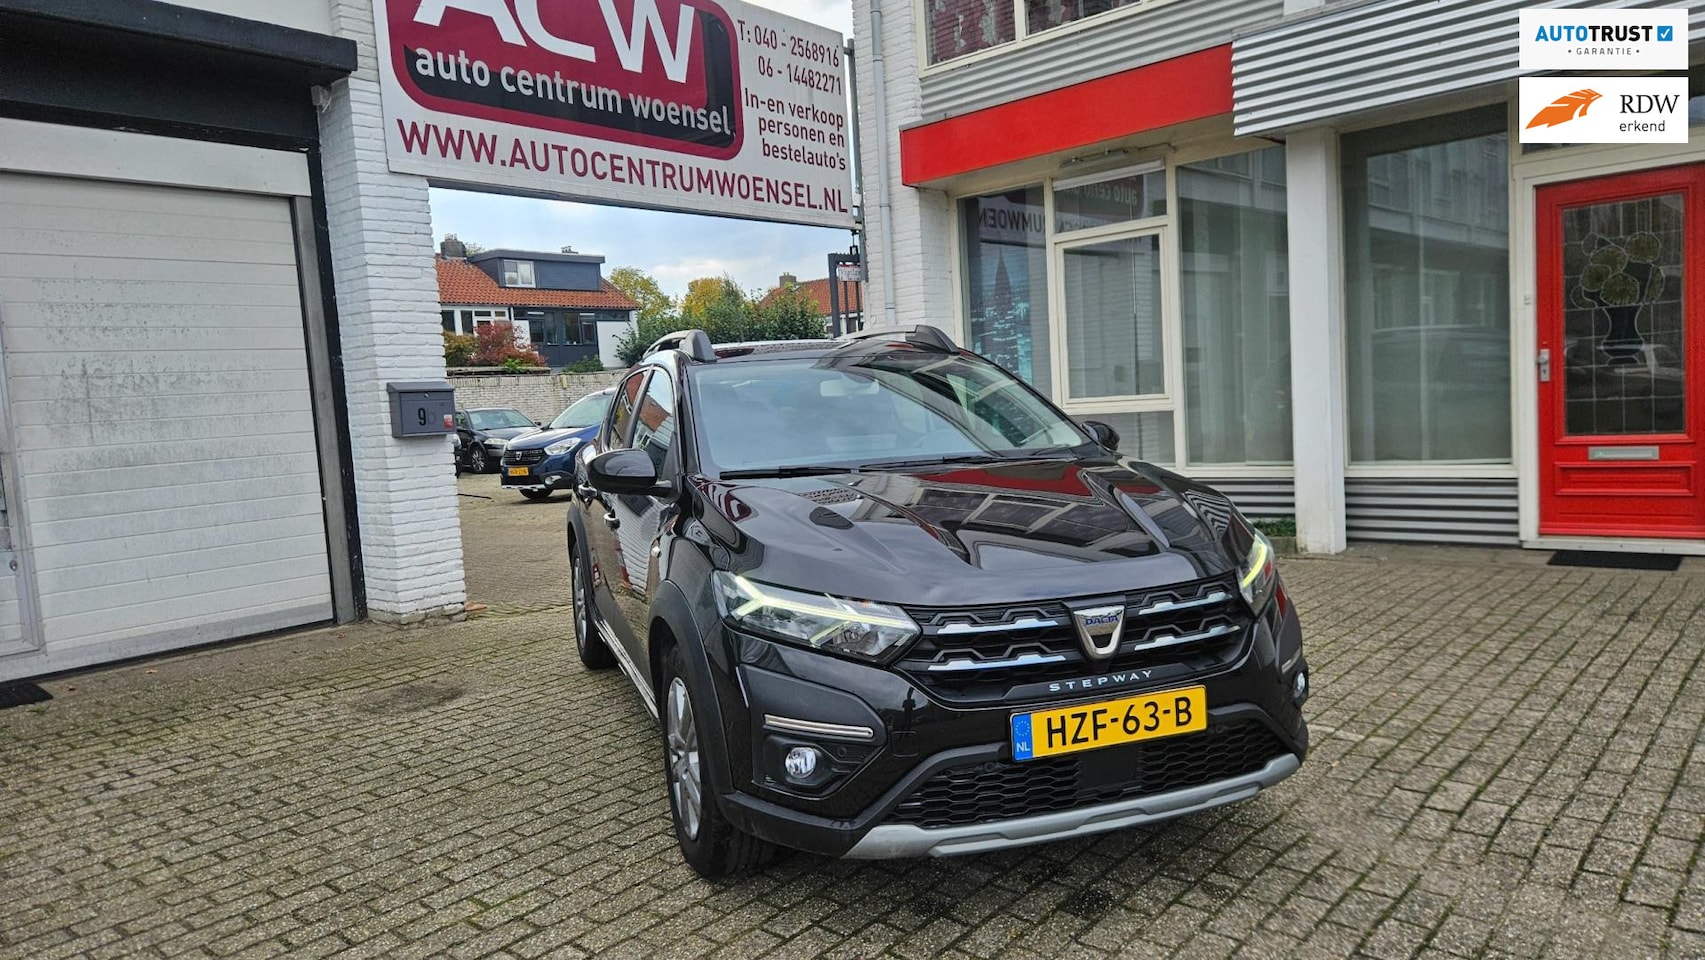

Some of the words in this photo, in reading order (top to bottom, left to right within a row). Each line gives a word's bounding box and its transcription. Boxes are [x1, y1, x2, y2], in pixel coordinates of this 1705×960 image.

[738, 19, 752, 43] T:
[754, 25, 778, 50] 040
[790, 35, 840, 68] 2568916
[415, 47, 491, 87] auto
[500, 66, 623, 115] centrum
[629, 92, 731, 136] woensel
[758, 55, 773, 78] 06
[786, 63, 842, 96] 14482271
[745, 87, 785, 115] In-en
[788, 102, 844, 132] verkoop
[758, 116, 826, 144] personen
[829, 132, 845, 148] en
[396, 118, 848, 214] WWW.AUTOCENTRUMWOENSEL.NL
[762, 138, 846, 171] bestelauto's
[1085, 614, 1119, 626] DACIA
[1048, 669, 1153, 692] STEPWAY
[1016, 742, 1031, 753] NL
[1046, 697, 1192, 749] HZF-63-B
